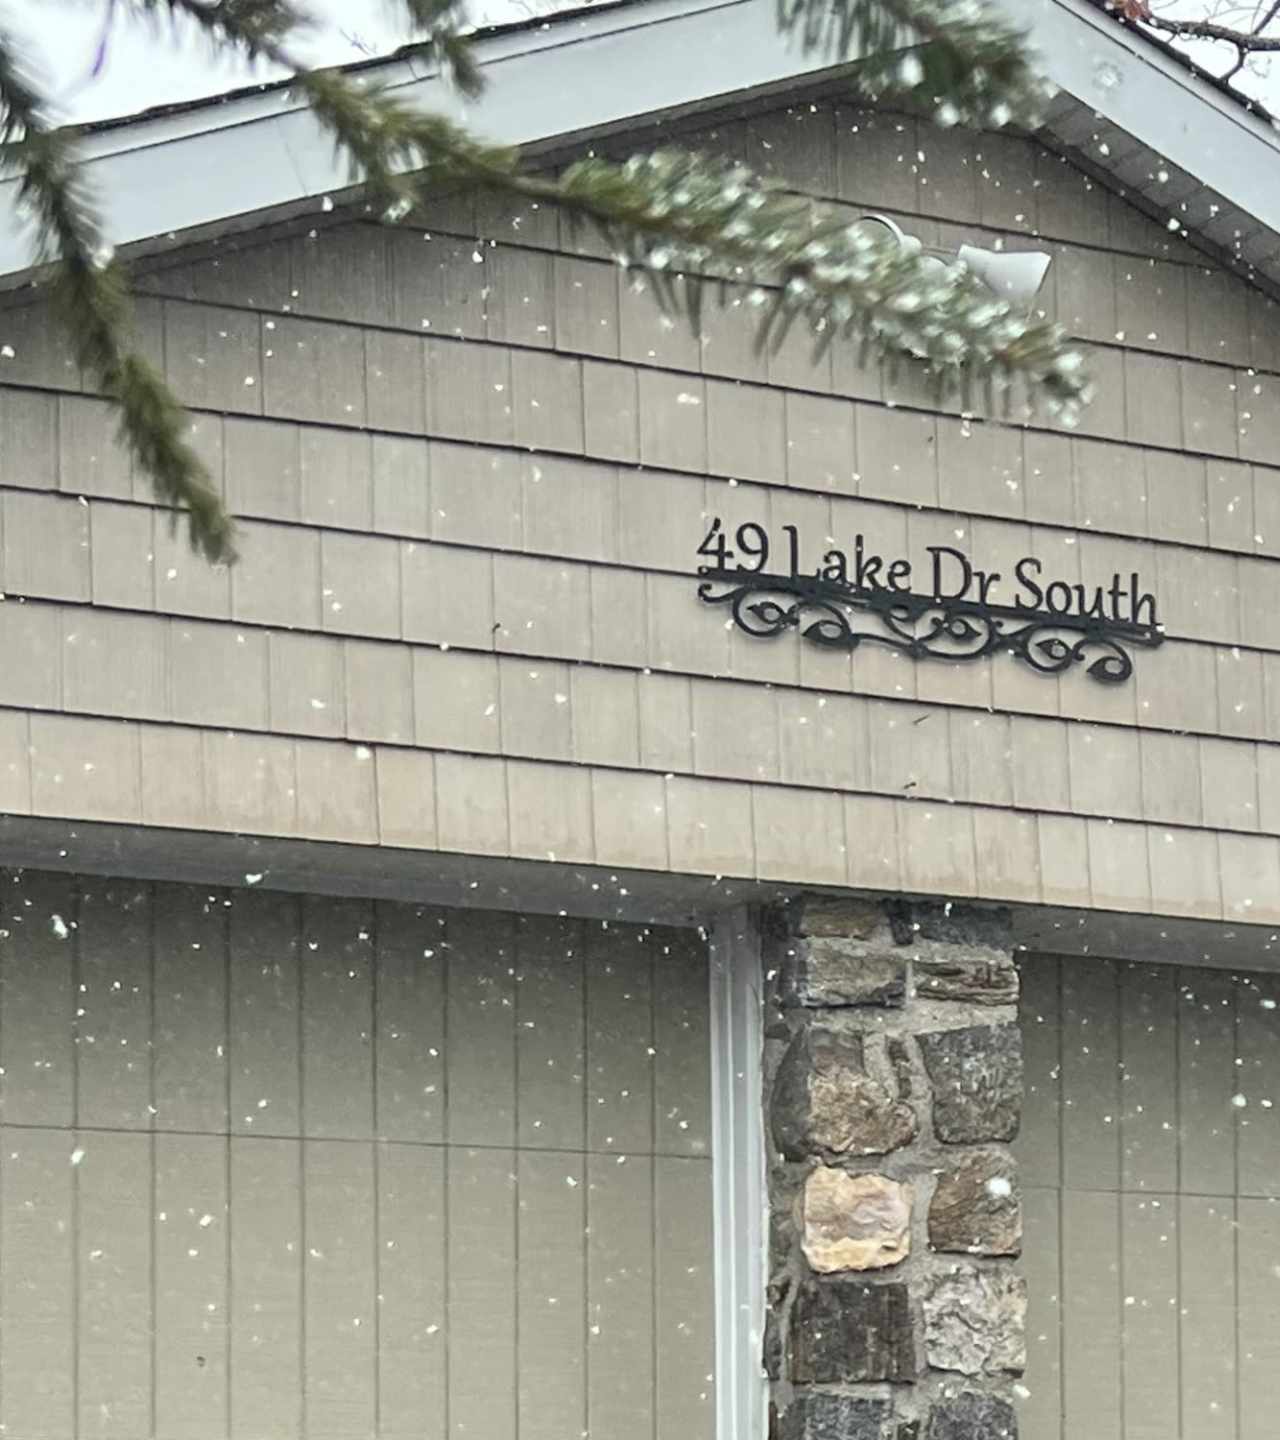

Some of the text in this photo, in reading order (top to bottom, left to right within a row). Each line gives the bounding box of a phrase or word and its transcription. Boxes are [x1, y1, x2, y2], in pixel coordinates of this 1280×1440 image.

[697, 518, 1158, 626] 49 Lake Dr South
